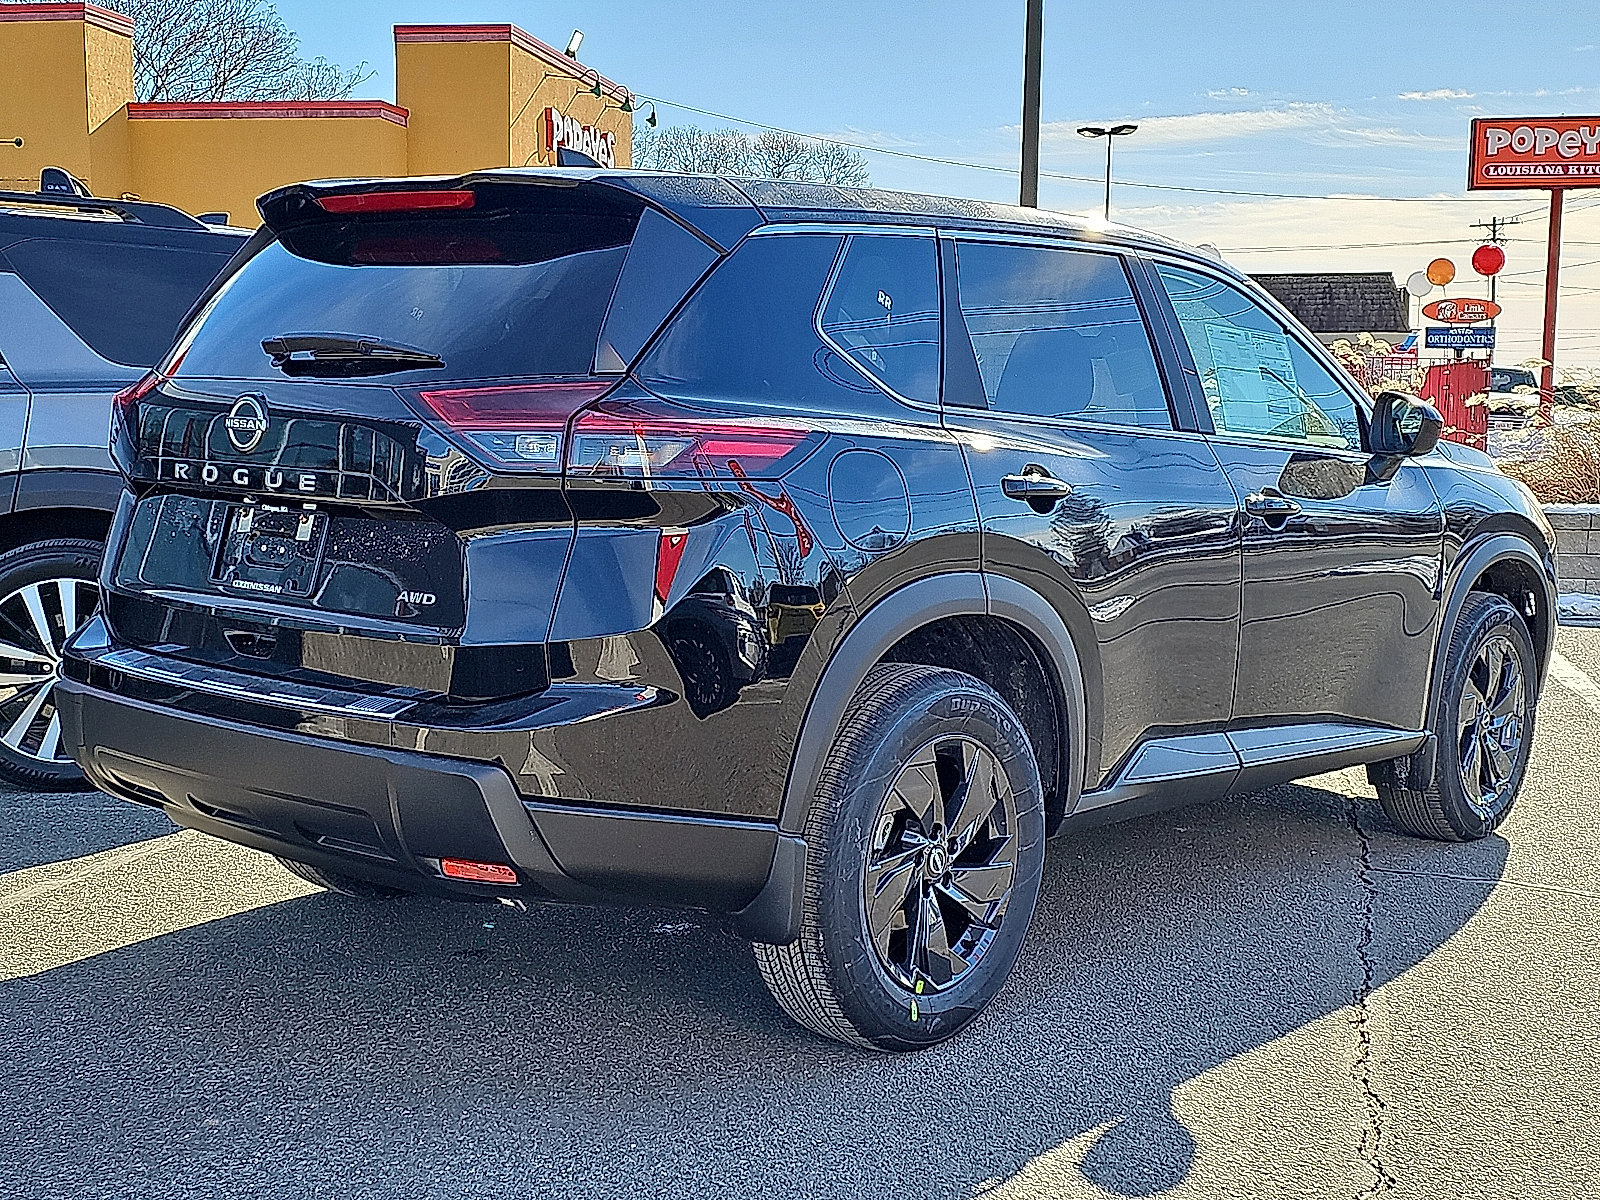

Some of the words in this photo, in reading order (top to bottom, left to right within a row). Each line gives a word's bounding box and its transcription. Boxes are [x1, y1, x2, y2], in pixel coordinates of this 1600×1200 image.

[1488, 165, 1564, 175] LOUISIANA
[1458, 310, 1488, 320] Caesars
[1427, 334, 1495, 344] ORTHODONTICS
[225, 418, 266, 431] NISSAN
[174, 462, 317, 492] ROGUE
[395, 590, 437, 605] AWD
